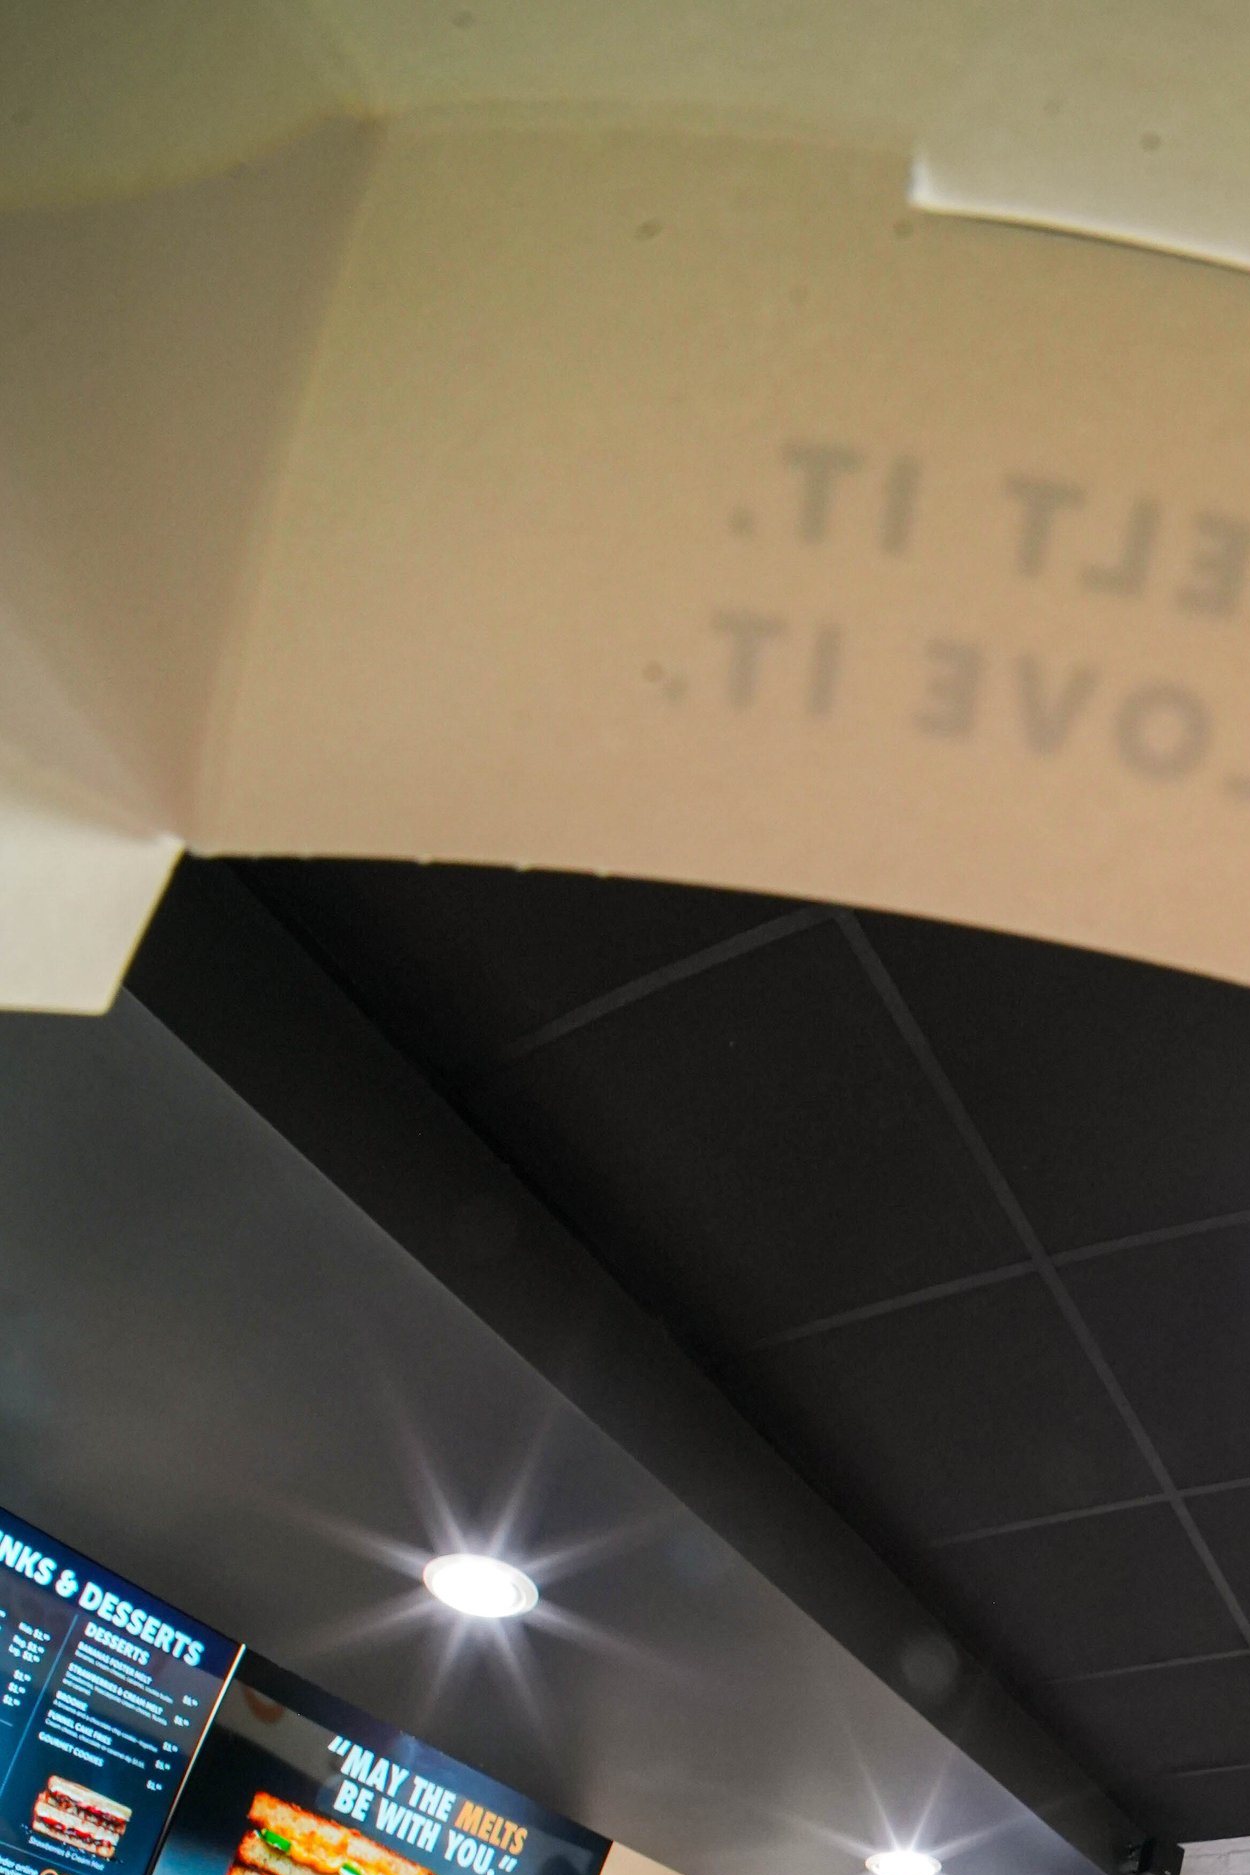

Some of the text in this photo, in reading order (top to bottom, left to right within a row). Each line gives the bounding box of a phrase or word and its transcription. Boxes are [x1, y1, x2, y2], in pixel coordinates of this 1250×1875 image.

[0, 1530, 205, 1666] NKS & DESSERTS
[84, 1621, 150, 1666] DESSERTS
[333, 1779, 375, 1822] BE
[375, 1797, 443, 1853] WITH
[408, 1775, 457, 1823] THE
[454, 1800, 528, 1856] MELTS
